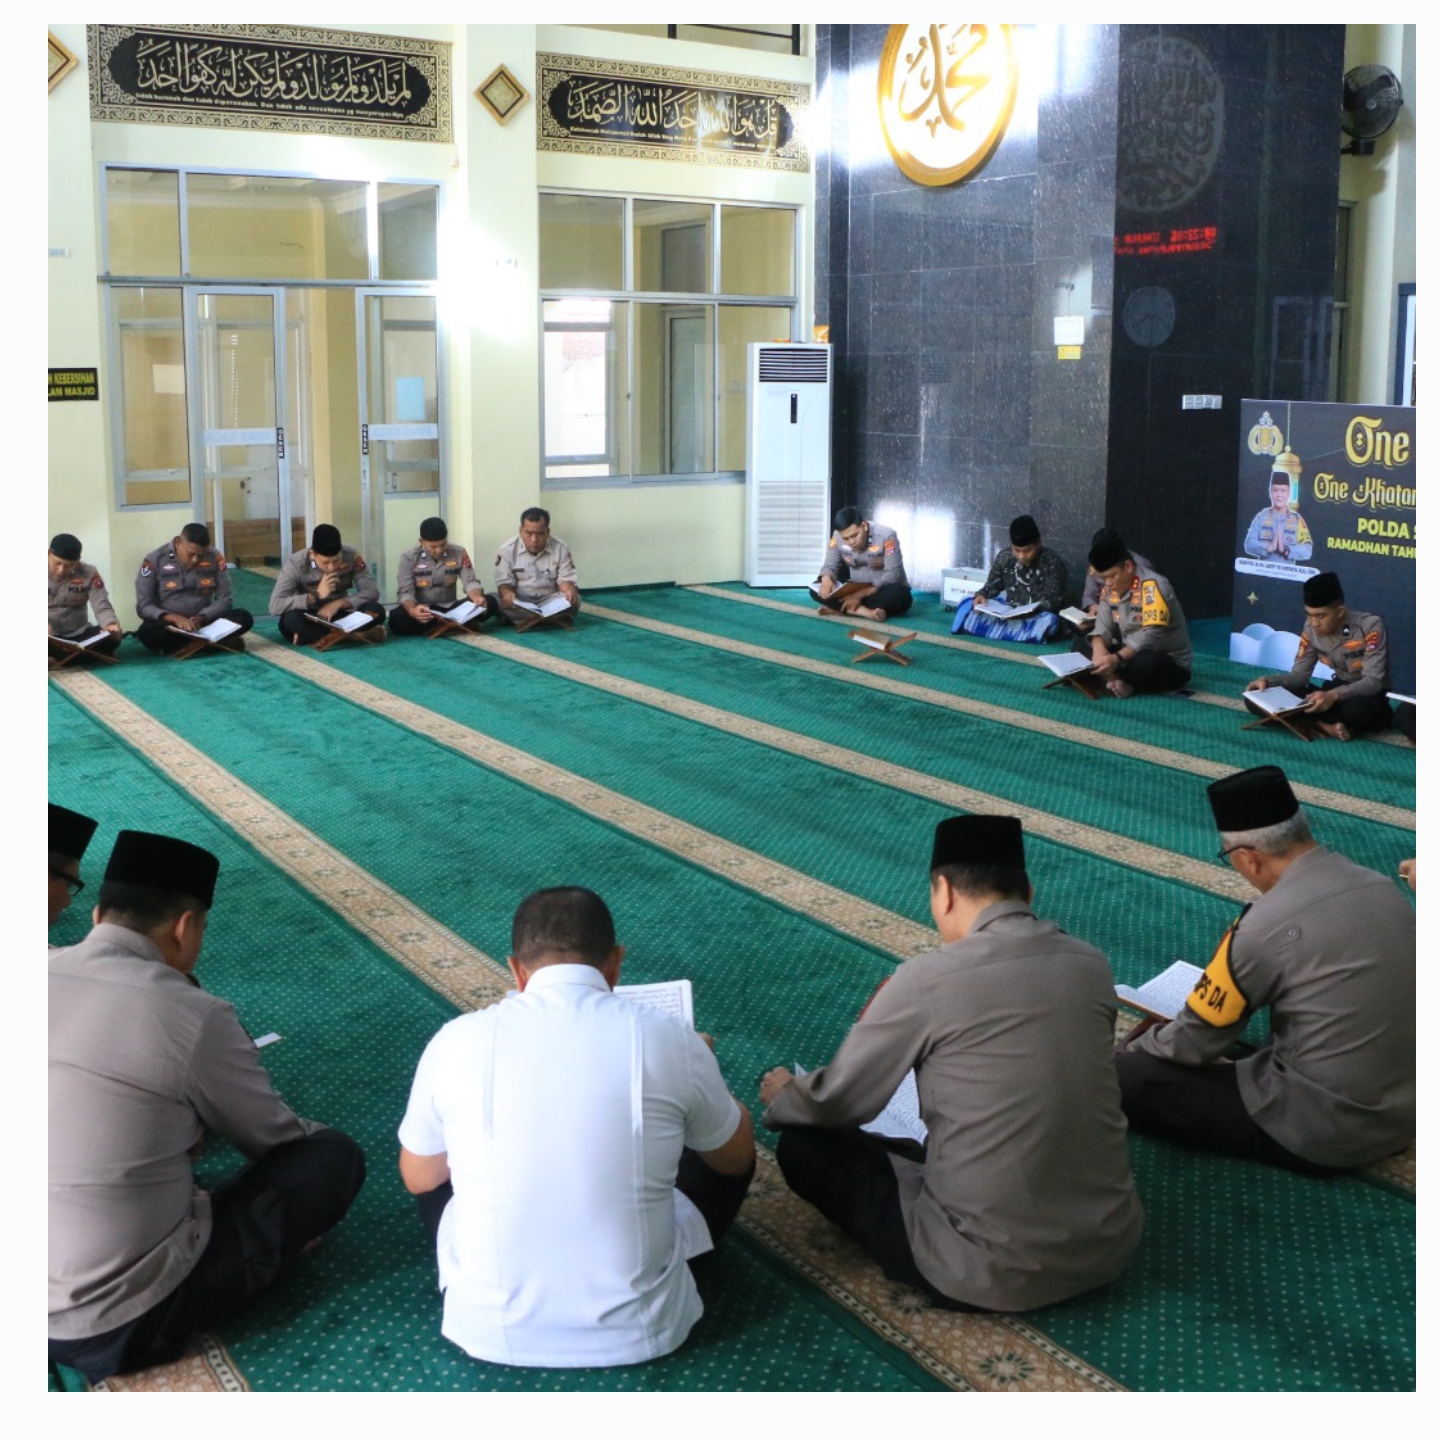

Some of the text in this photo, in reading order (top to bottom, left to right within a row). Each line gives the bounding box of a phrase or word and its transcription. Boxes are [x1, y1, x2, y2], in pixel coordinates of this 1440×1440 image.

[1345, 416, 1410, 466] One
[1314, 472, 1349, 501] One
[1357, 517, 1410, 539] POLDA
[1327, 536, 1390, 556] RAMADHAN
[1208, 985, 1228, 1013] DA
